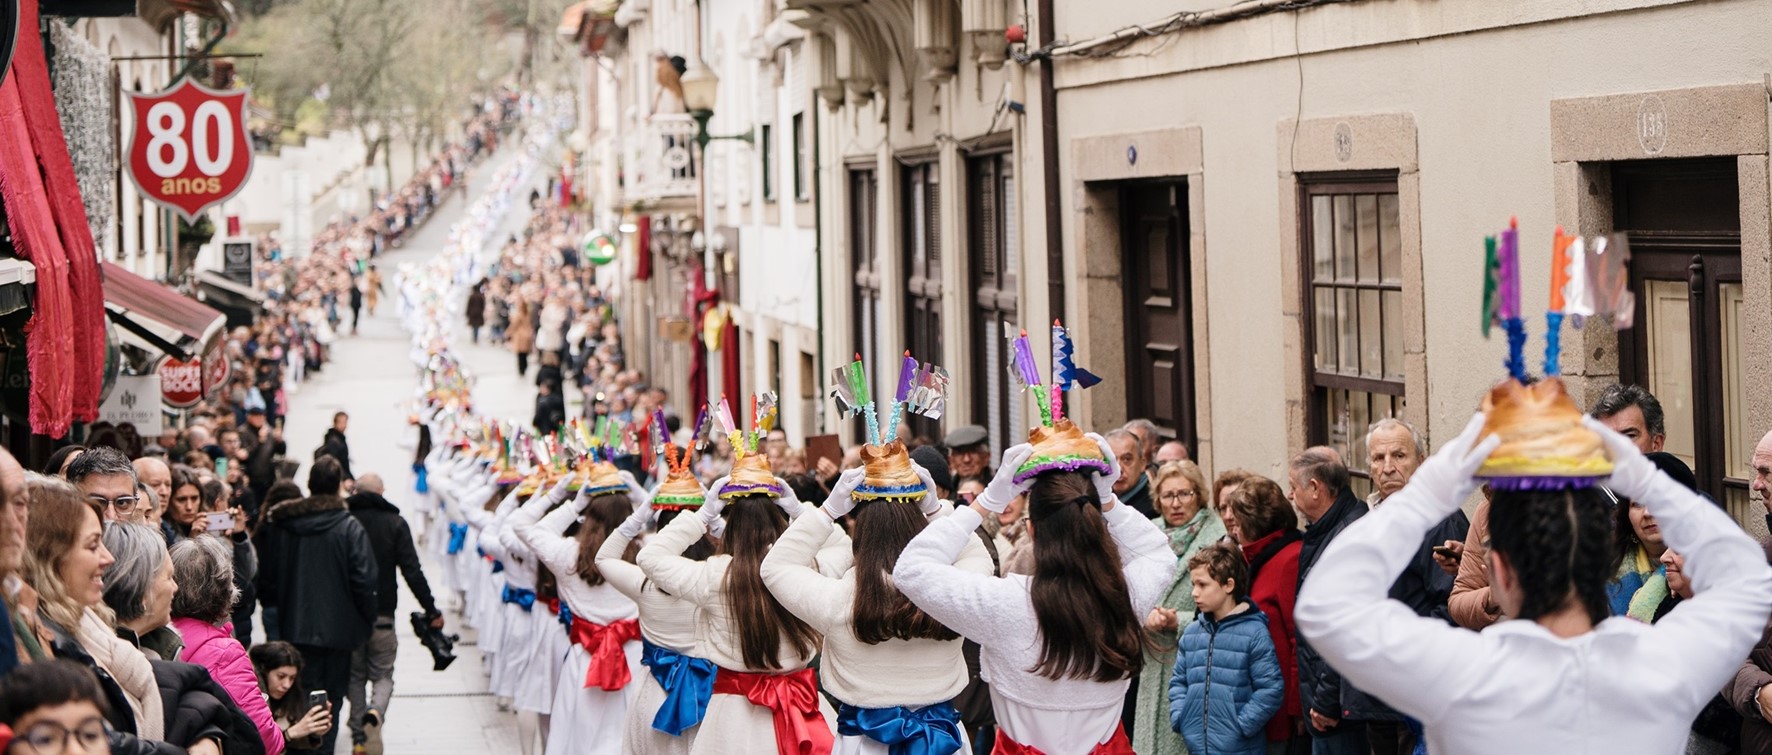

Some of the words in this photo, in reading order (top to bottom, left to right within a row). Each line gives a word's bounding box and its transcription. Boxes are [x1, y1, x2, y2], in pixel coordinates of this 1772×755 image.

[146, 100, 234, 178] 80
[161, 177, 222, 195] anos
[161, 377, 201, 393] BOCK
